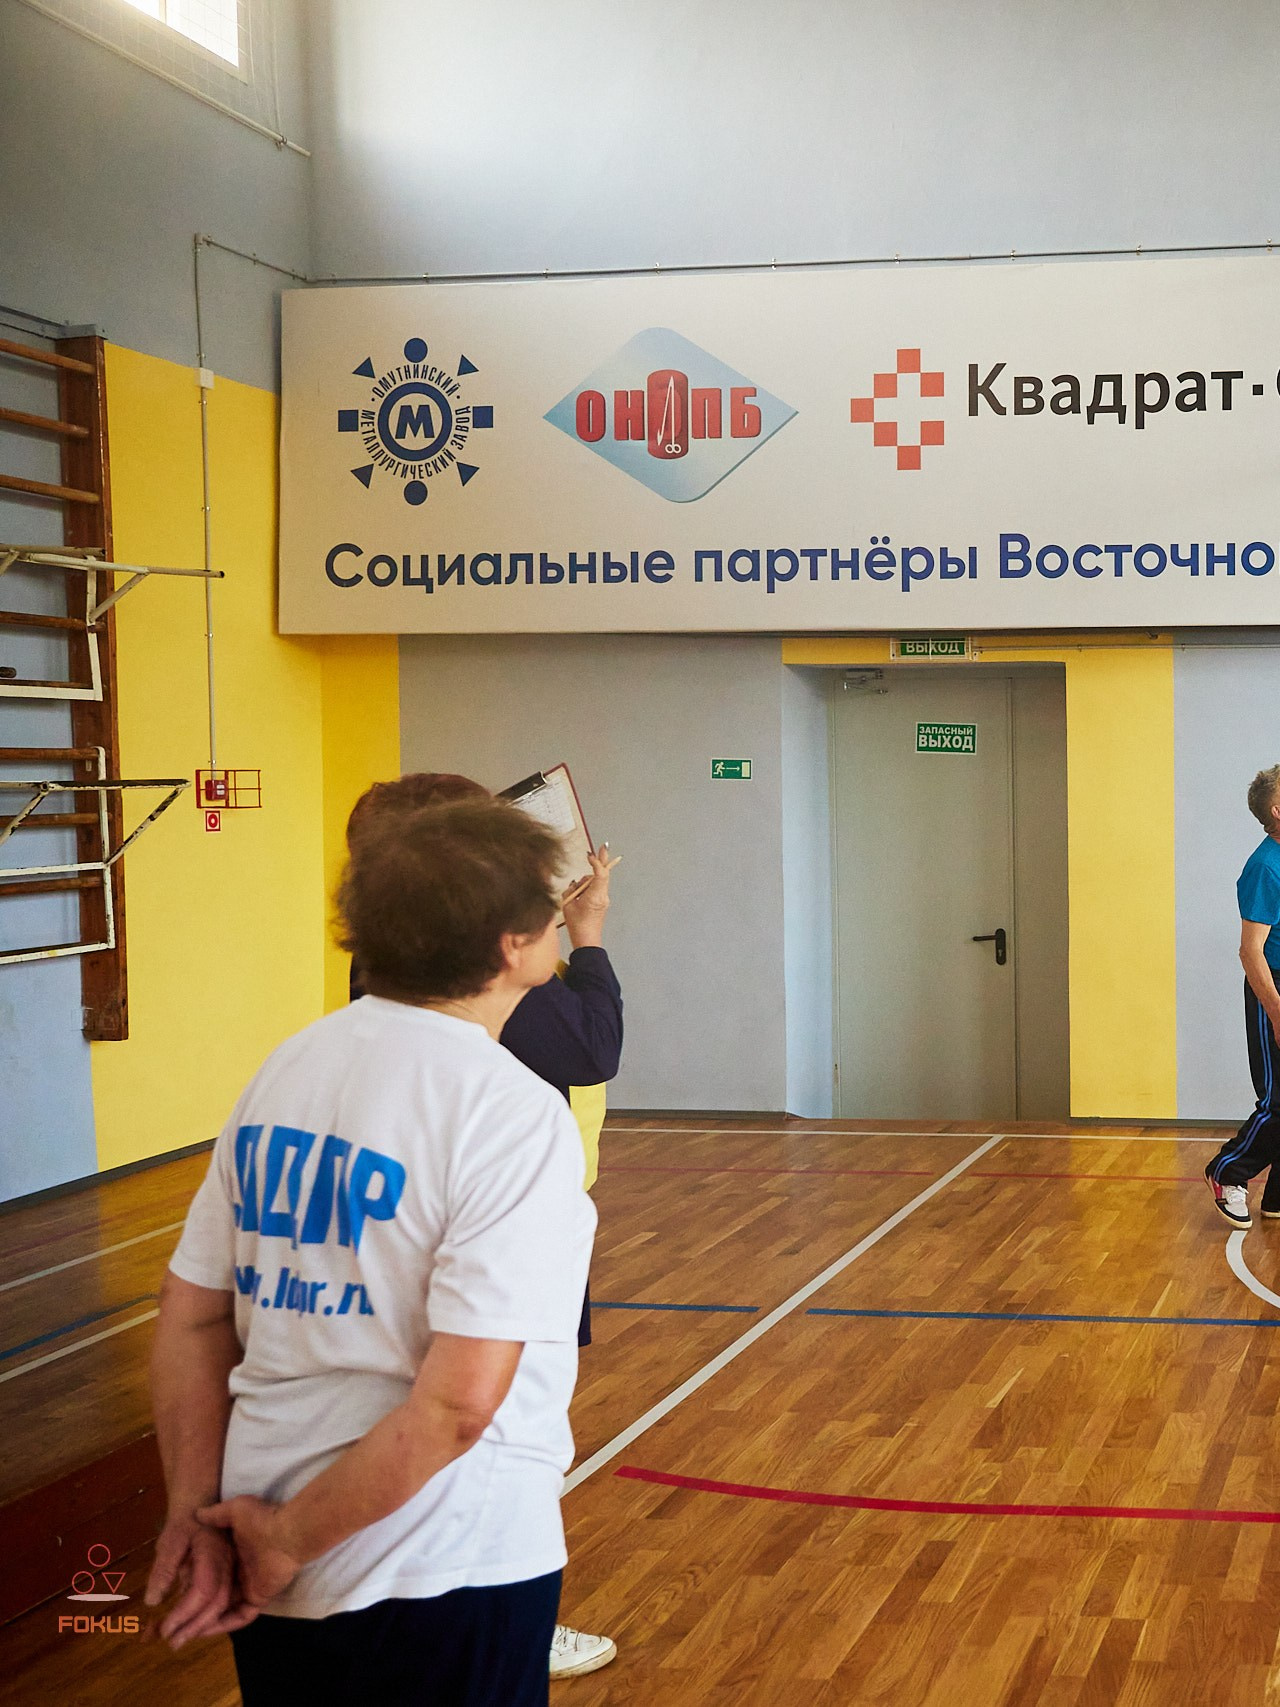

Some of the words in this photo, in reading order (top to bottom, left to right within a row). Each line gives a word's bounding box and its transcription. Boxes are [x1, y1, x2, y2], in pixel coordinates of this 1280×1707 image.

[372, 364, 461, 398] ОМУТНИНСКИЙ
[360, 409, 457, 479] МЕТАЛЛУРГИЧЕСКИЙ
[450, 405, 471, 450] ЗАВОД
[325, 543, 675, 594] Социальные
[694, 536, 978, 594] партнёры
[906, 641, 960, 653] ВЫХОД
[918, 735, 973, 751] ВЫХОД
[919, 726, 973, 736] ЗАПАСНЫЙ
